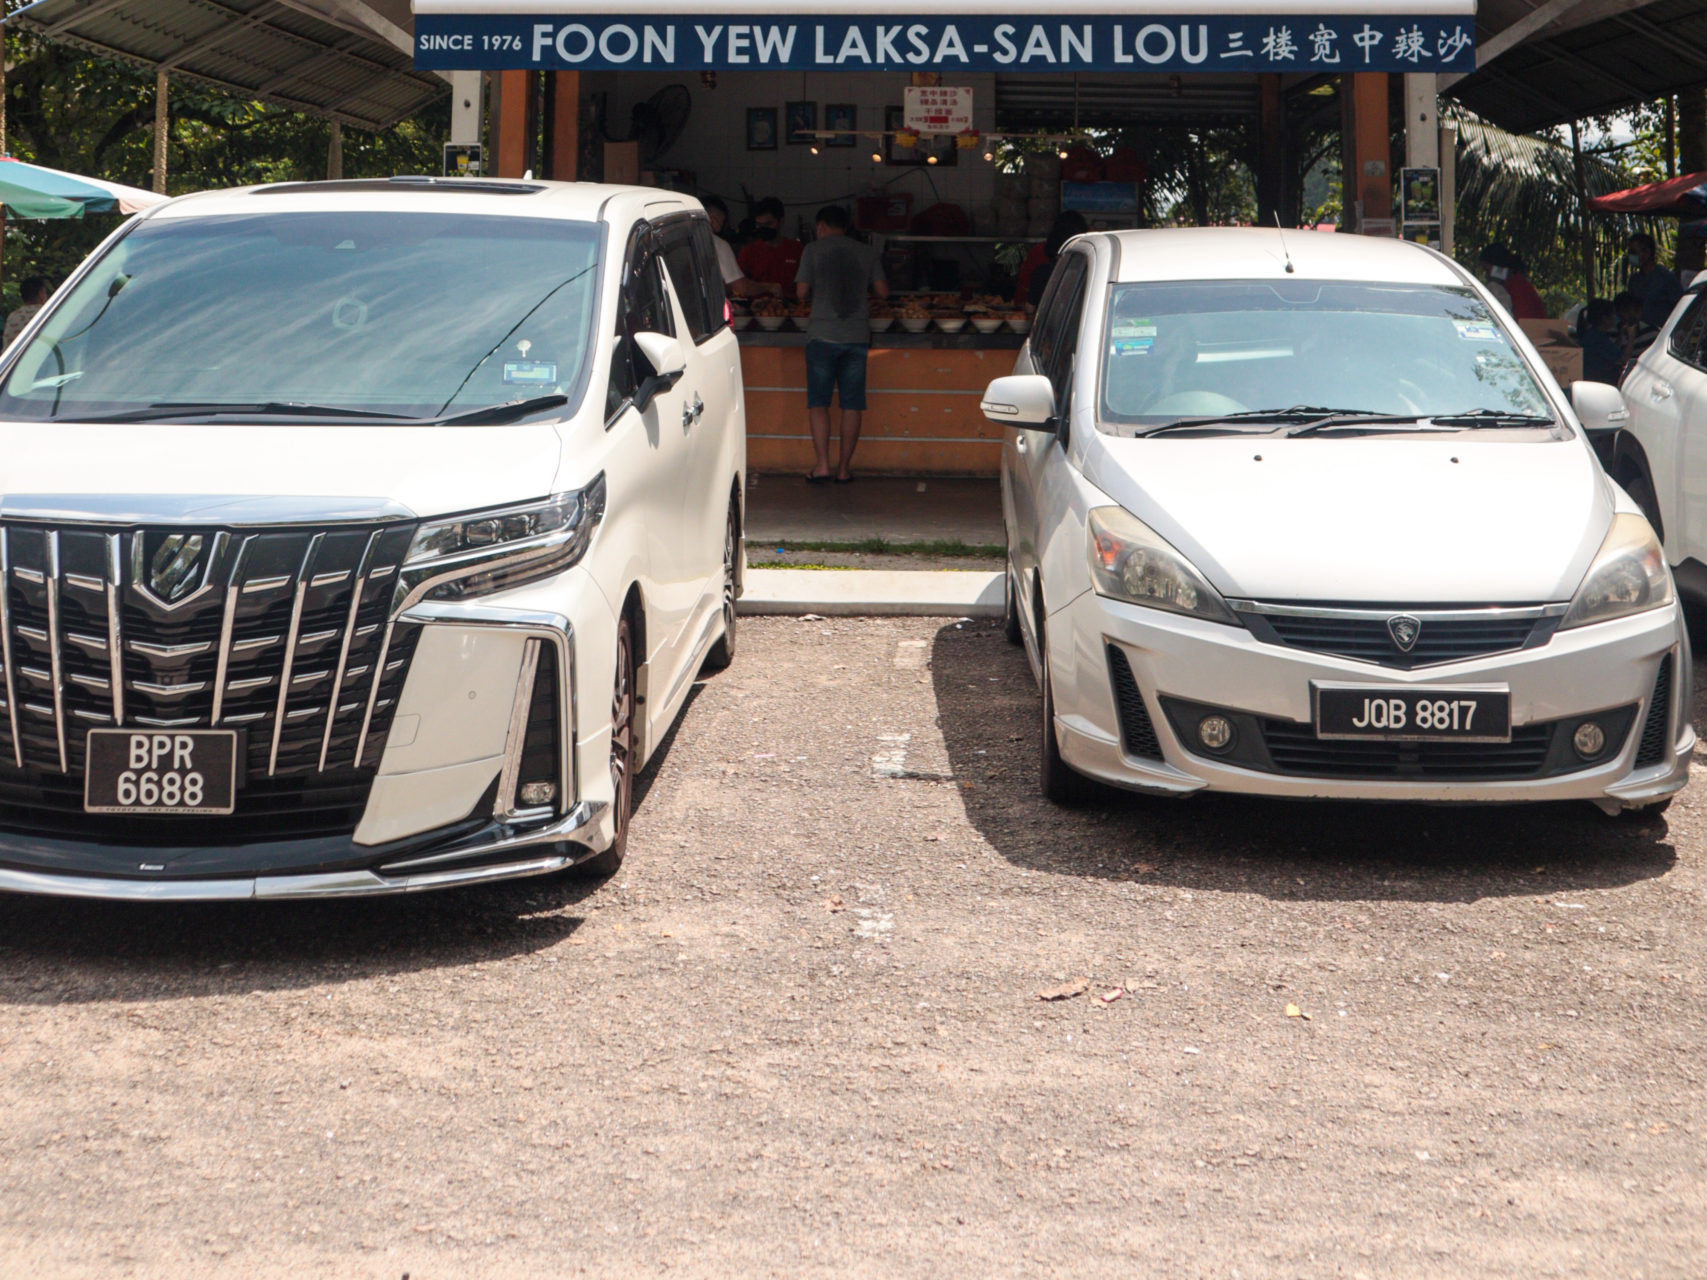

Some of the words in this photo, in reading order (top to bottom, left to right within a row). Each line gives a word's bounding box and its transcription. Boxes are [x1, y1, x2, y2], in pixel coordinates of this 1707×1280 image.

[419, 34, 473, 50] SINCE
[482, 35, 522, 51] 1976
[532, 23, 675, 63] FOON
[694, 25, 797, 64] YEW
[815, 23, 1093, 64] LAKSA-SAN
[1113, 23, 1208, 64] LOU
[1219, 22, 1473, 64] 三楼宽中辣沙
[1352, 698, 1407, 729] JQB
[1415, 699, 1478, 731] 8817
[129, 734, 194, 770] BPR
[117, 771, 204, 807] 6688
